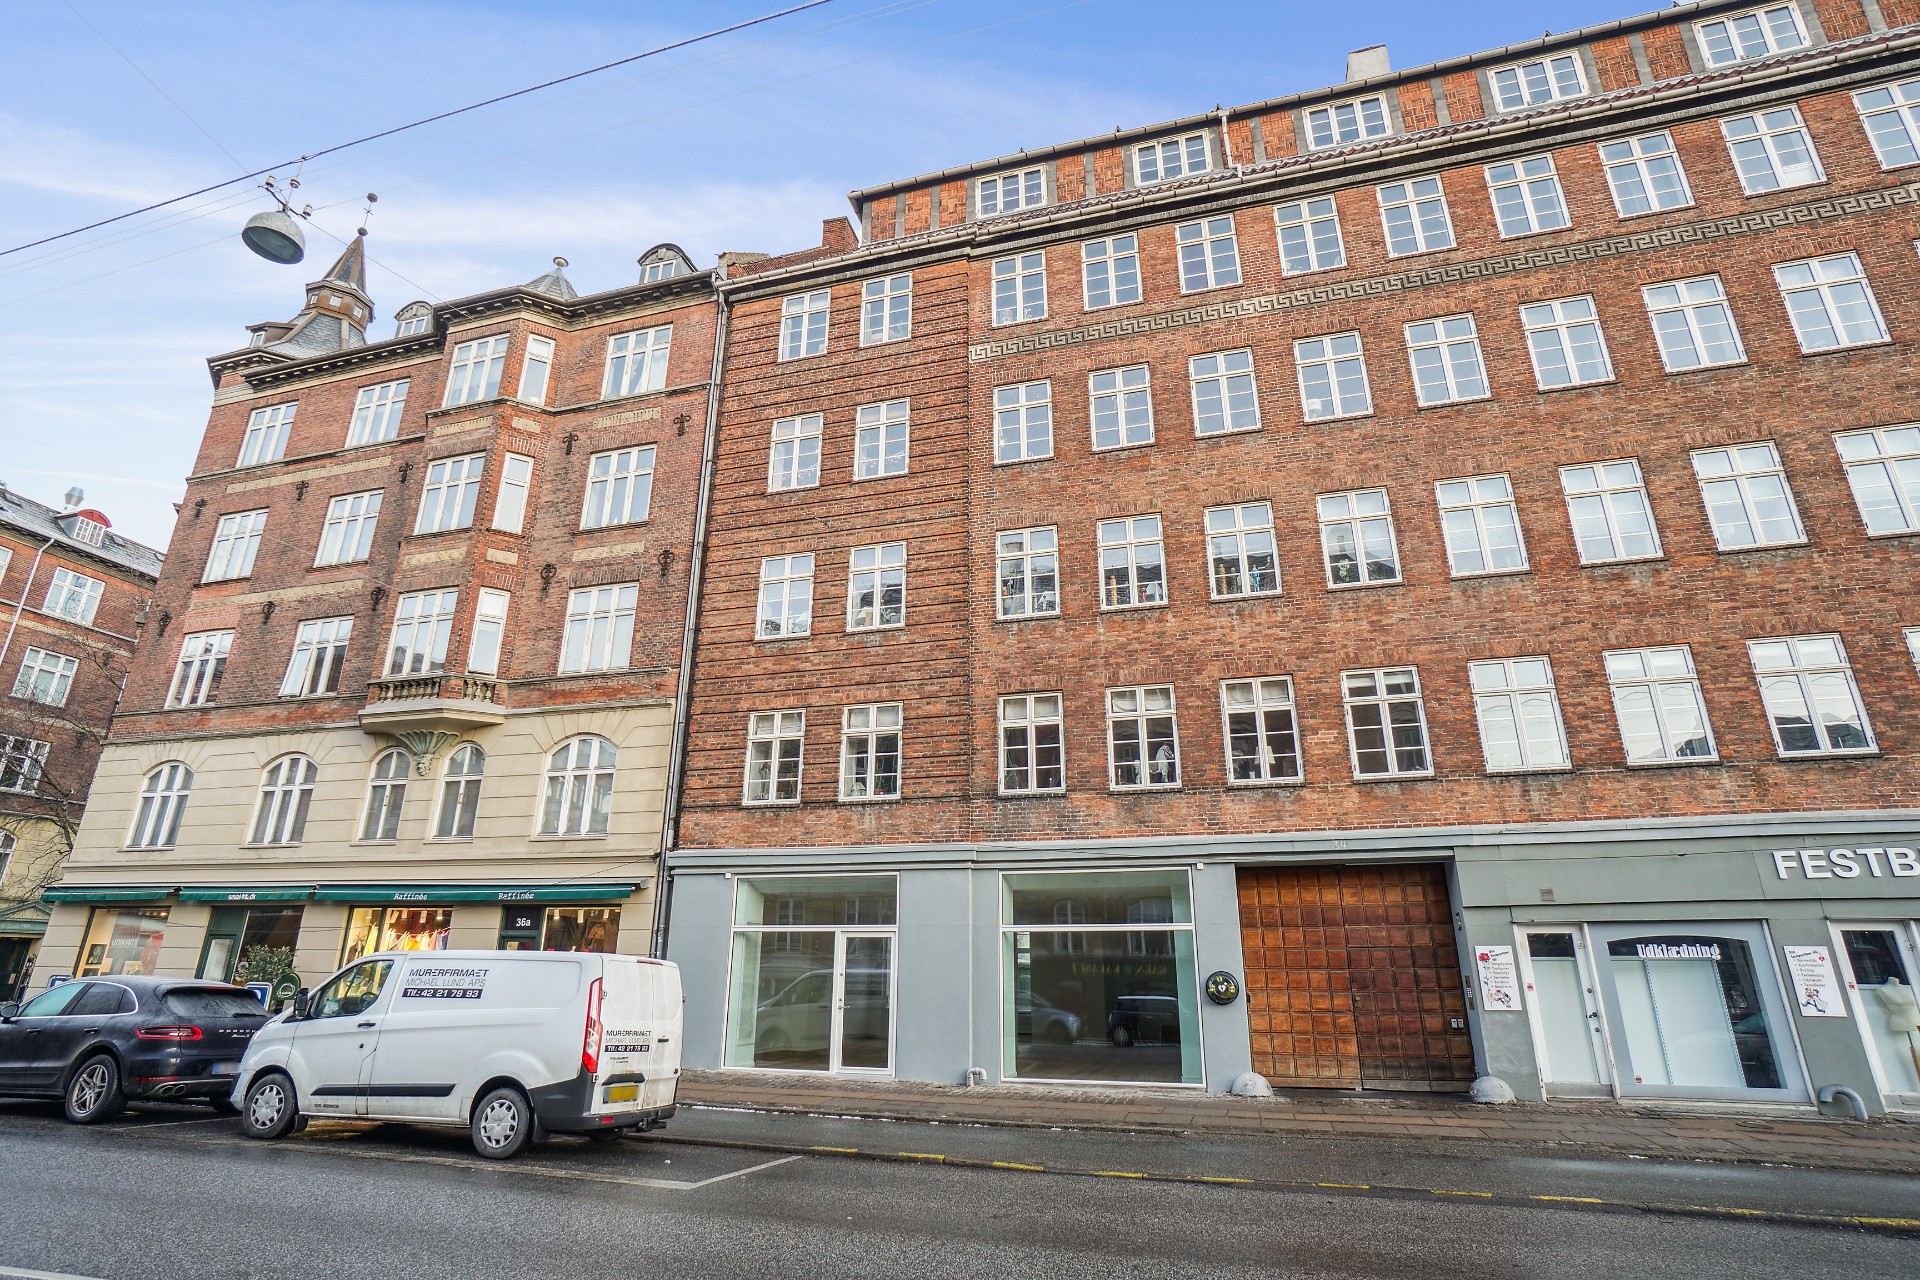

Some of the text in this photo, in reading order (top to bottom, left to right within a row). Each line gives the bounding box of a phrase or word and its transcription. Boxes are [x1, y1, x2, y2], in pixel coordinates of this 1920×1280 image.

[1332, 840, 1348, 849] 34
[1771, 846, 1920, 880] FESTB
[515, 917, 531, 927] 36a
[1635, 943, 1721, 960] Udklædning
[408, 968, 489, 977] MURERFIRMAET
[405, 978, 440, 986] MICHAEL
[467, 979, 487, 987] APS
[421, 989, 434, 997] 42
[436, 989, 448, 997] 21
[450, 990, 463, 998] 79
[465, 990, 479, 998] 93
